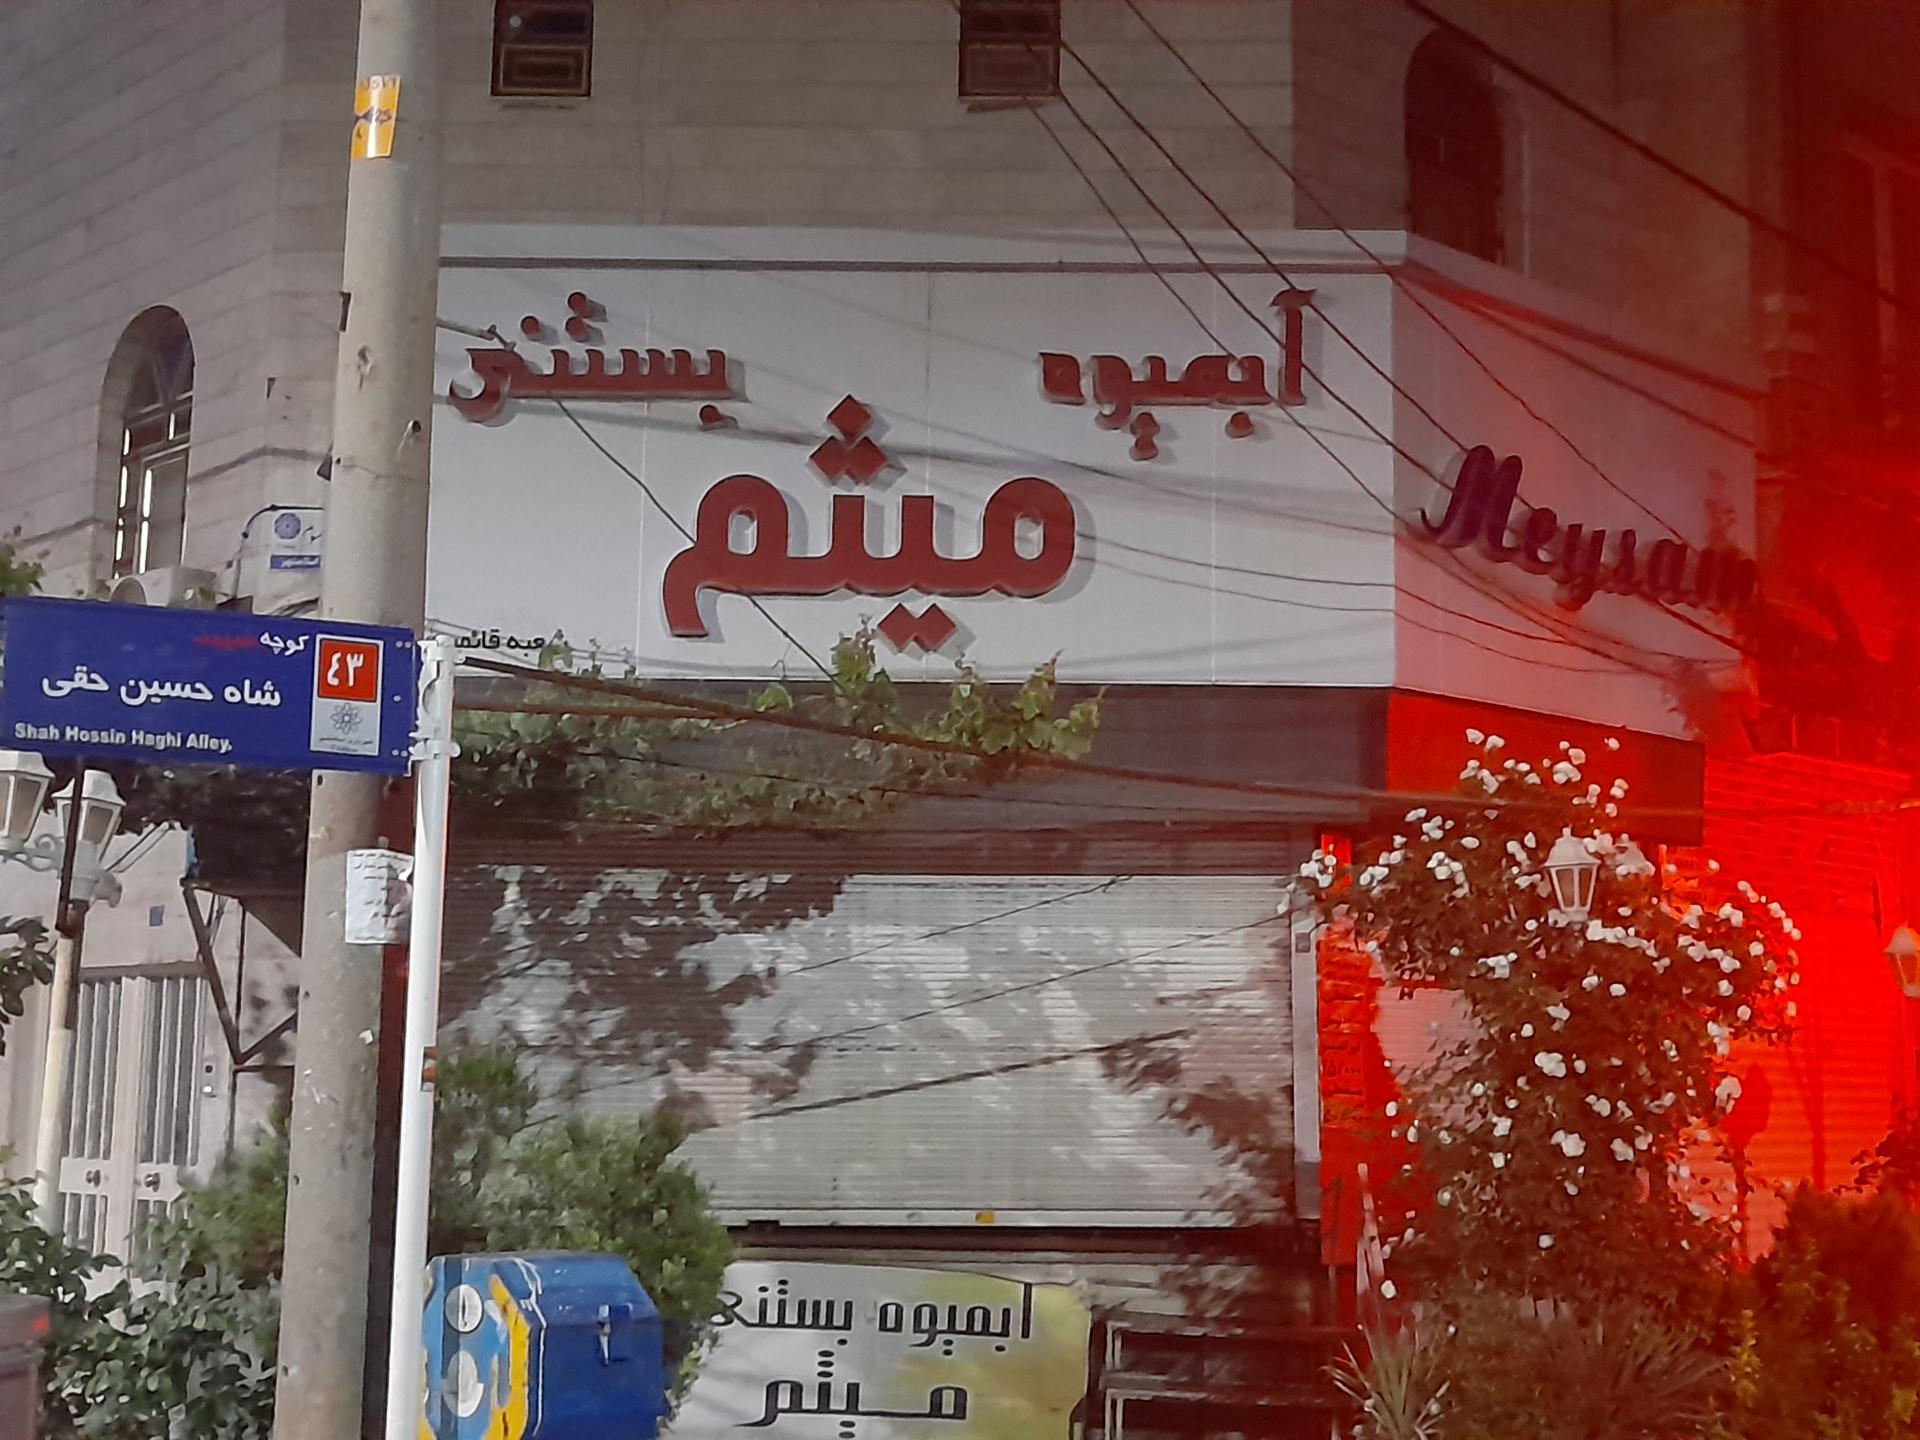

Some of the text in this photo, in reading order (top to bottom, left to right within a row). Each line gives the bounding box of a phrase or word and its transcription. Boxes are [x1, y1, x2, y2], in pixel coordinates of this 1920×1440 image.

[663, 393, 1077, 654] میثم
[259, 632, 310, 656] کوچه
[42, 665, 281, 706] شاه حسین حقی
[15, 722, 60, 740] Shah
[131, 729, 182, 750] Haghi
[733, 1350, 968, 1439] میثم
